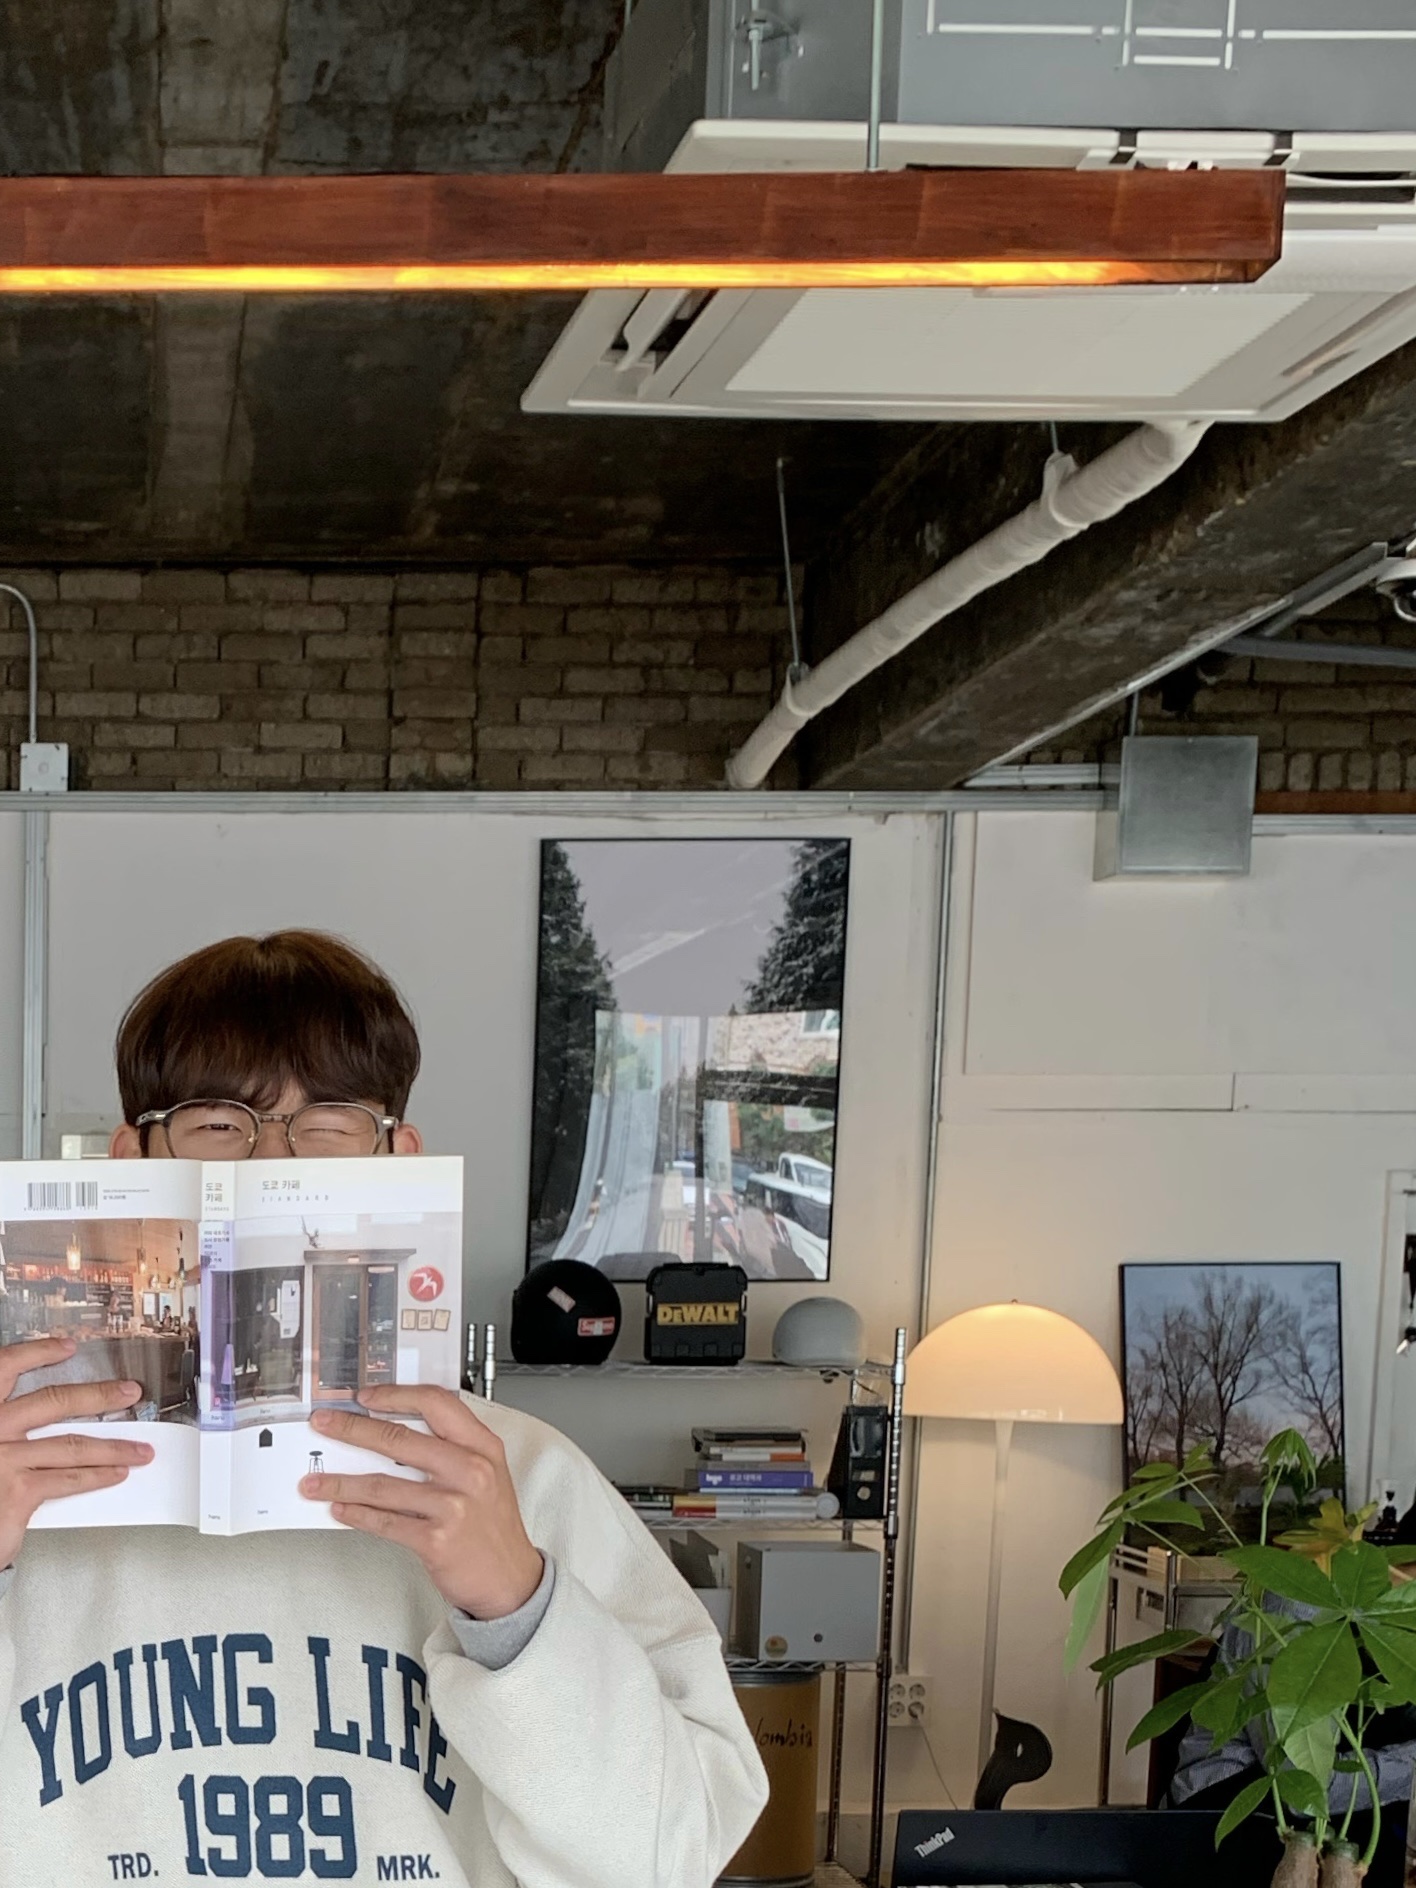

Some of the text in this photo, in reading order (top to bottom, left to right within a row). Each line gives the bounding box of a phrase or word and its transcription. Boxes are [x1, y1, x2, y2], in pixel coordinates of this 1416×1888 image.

[20, 1633, 456, 1815] YOUNG LIFE
[754, 1717, 813, 1748] lombia
[177, 1773, 358, 1879] 1989
[914, 1826, 955, 1858] ThinkPad
[107, 1852, 441, 1881] TRD. MRK.
